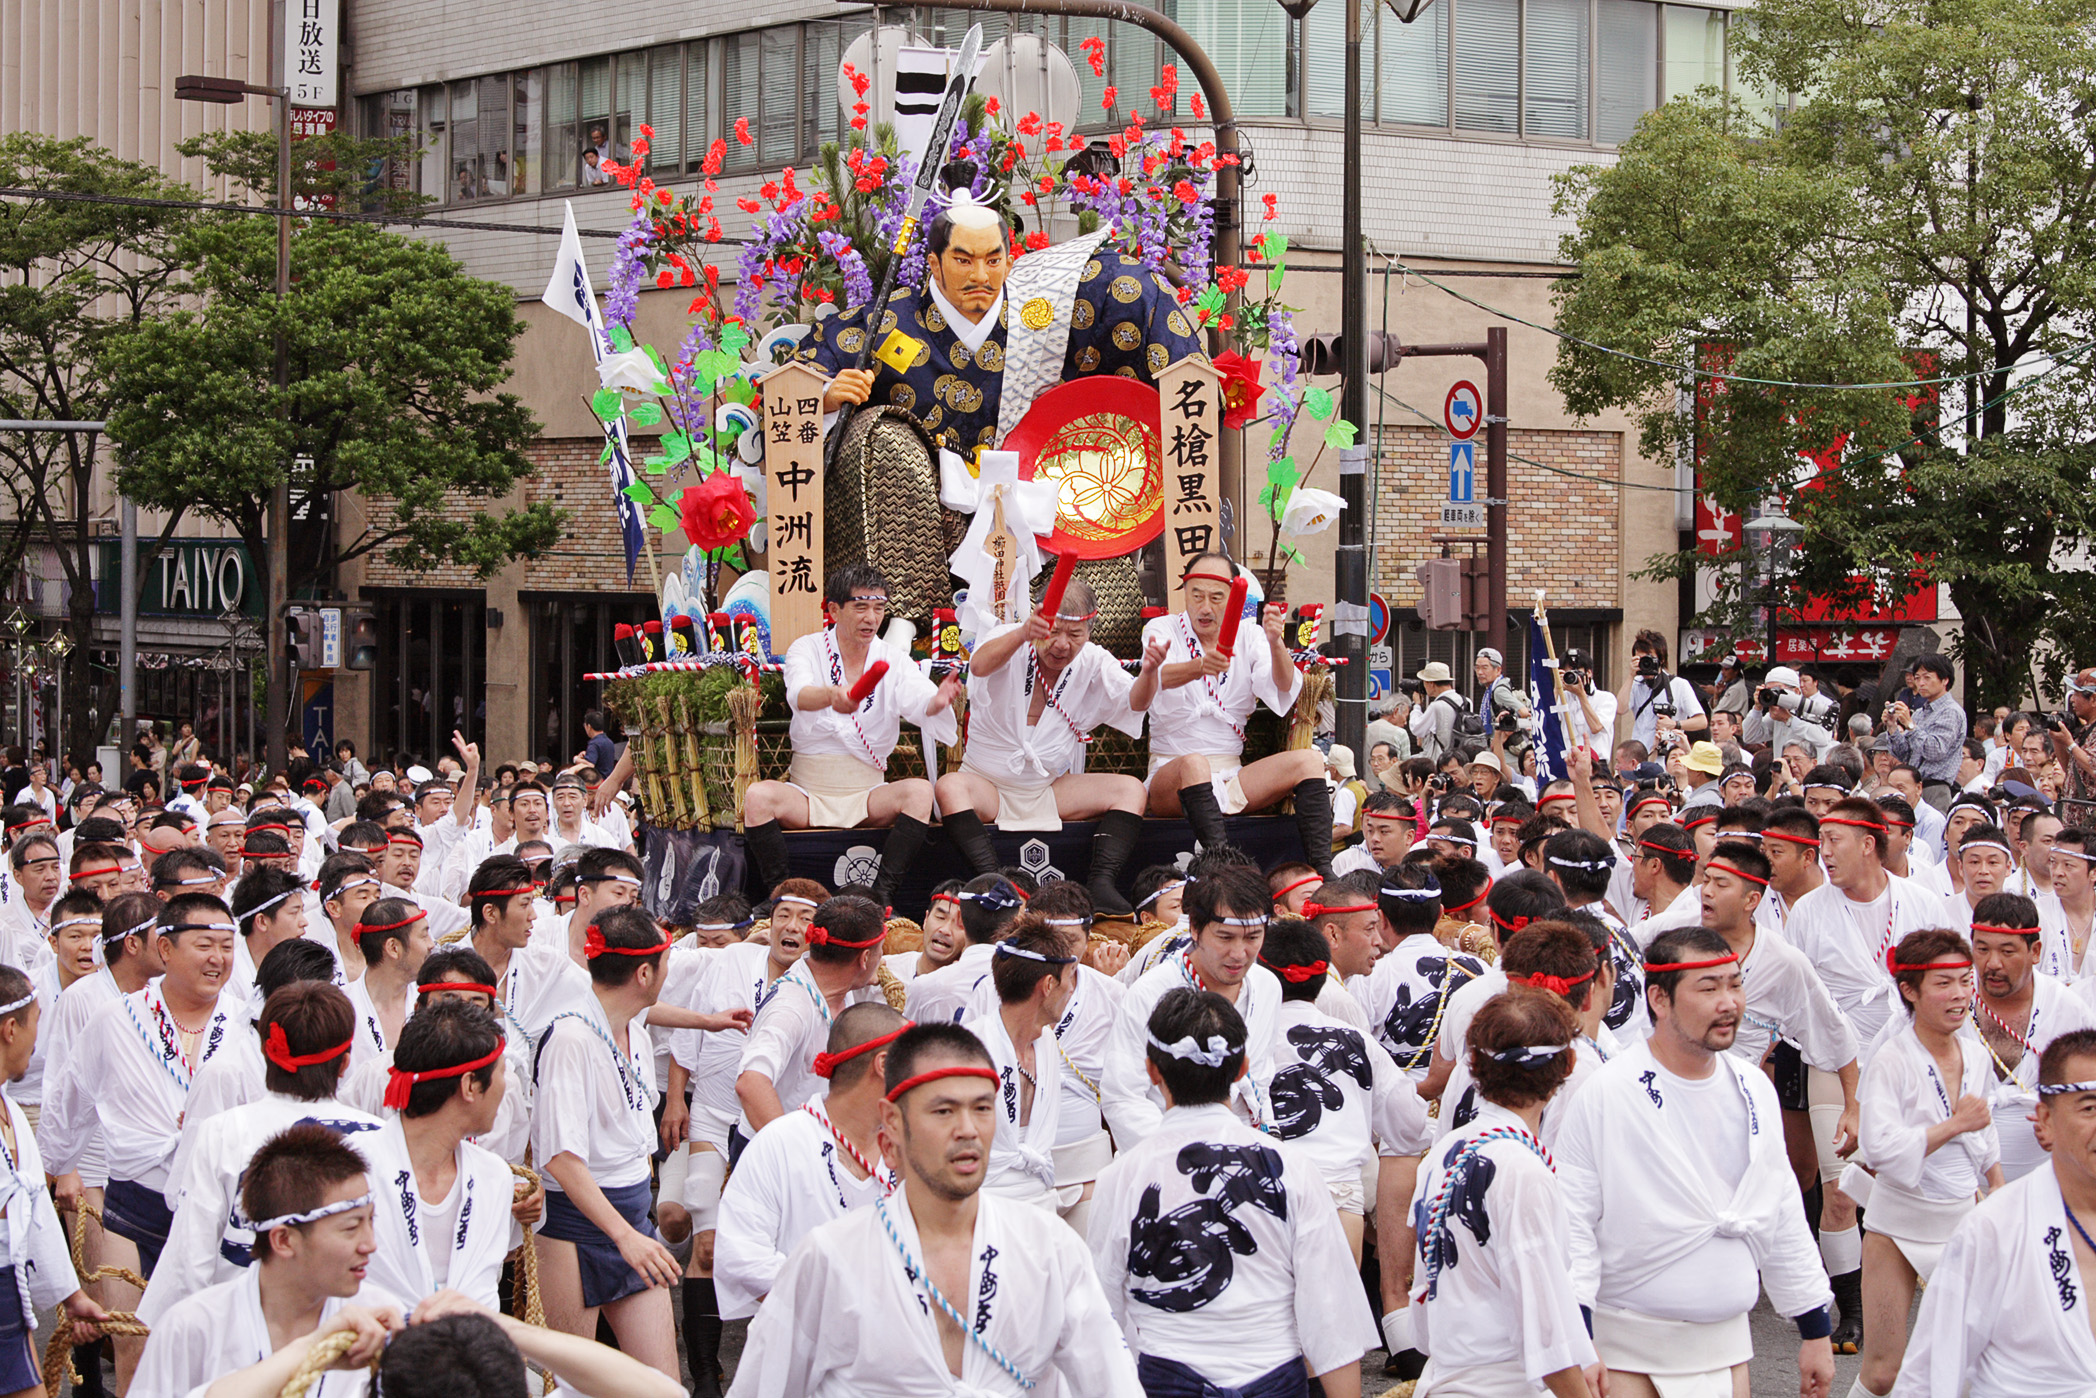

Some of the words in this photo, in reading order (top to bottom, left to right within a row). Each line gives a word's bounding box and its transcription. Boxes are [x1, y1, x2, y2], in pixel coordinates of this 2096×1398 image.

[769, 397, 792, 445] 山笠
[796, 397, 820, 445] 四番
[1166, 379, 1214, 592] 名槍黒田
[775, 460, 818, 596] 中洲流
[158, 546, 244, 612] TAIYO
